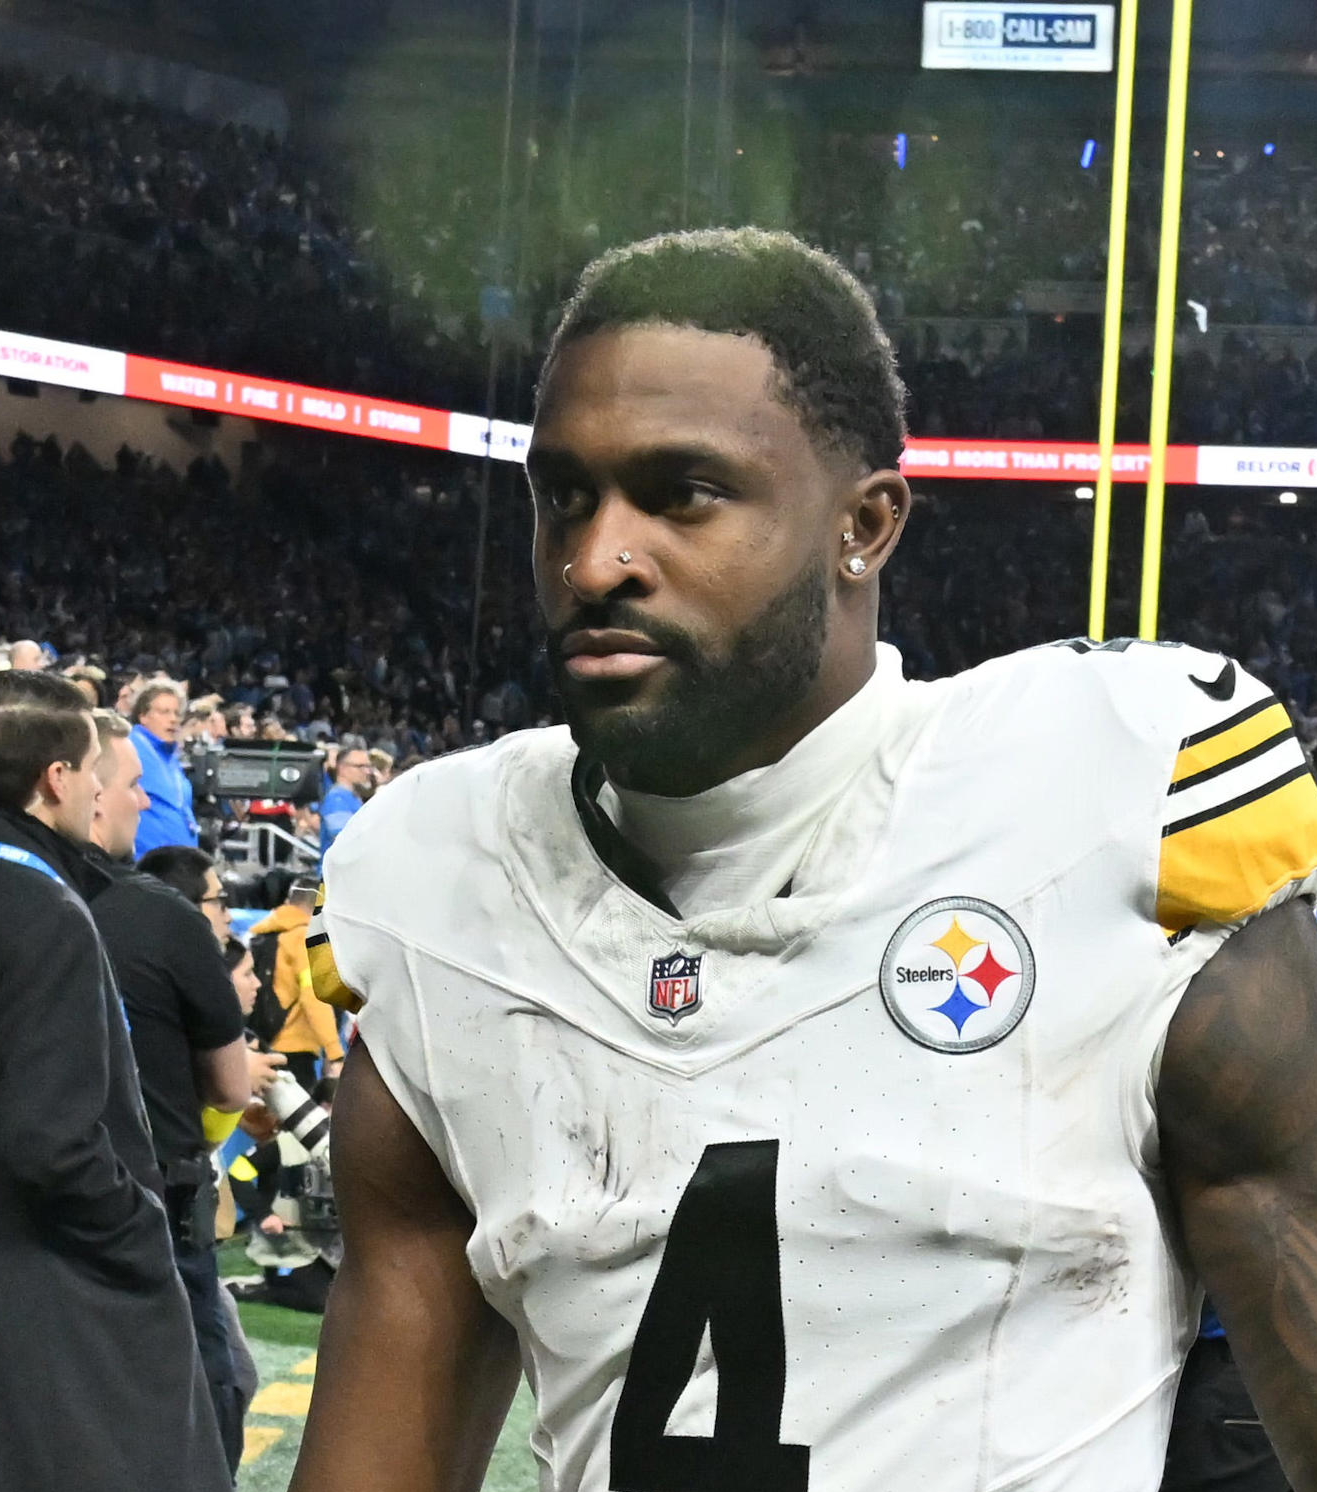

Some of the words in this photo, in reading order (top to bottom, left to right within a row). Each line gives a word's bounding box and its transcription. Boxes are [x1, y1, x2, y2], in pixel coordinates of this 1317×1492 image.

[160, 372, 216, 399] WATER
[242, 386, 278, 410] FIRE
[302, 397, 346, 421] MOLD
[369, 409, 421, 434] STORM
[954, 450, 1007, 468] MORE
[1012, 452, 1059, 469] THAN
[1063, 452, 1152, 472] PROERTY
[1237, 460, 1301, 473] BELFOR
[896, 966, 954, 985] Steelers
[655, 979, 696, 1008] NFL
